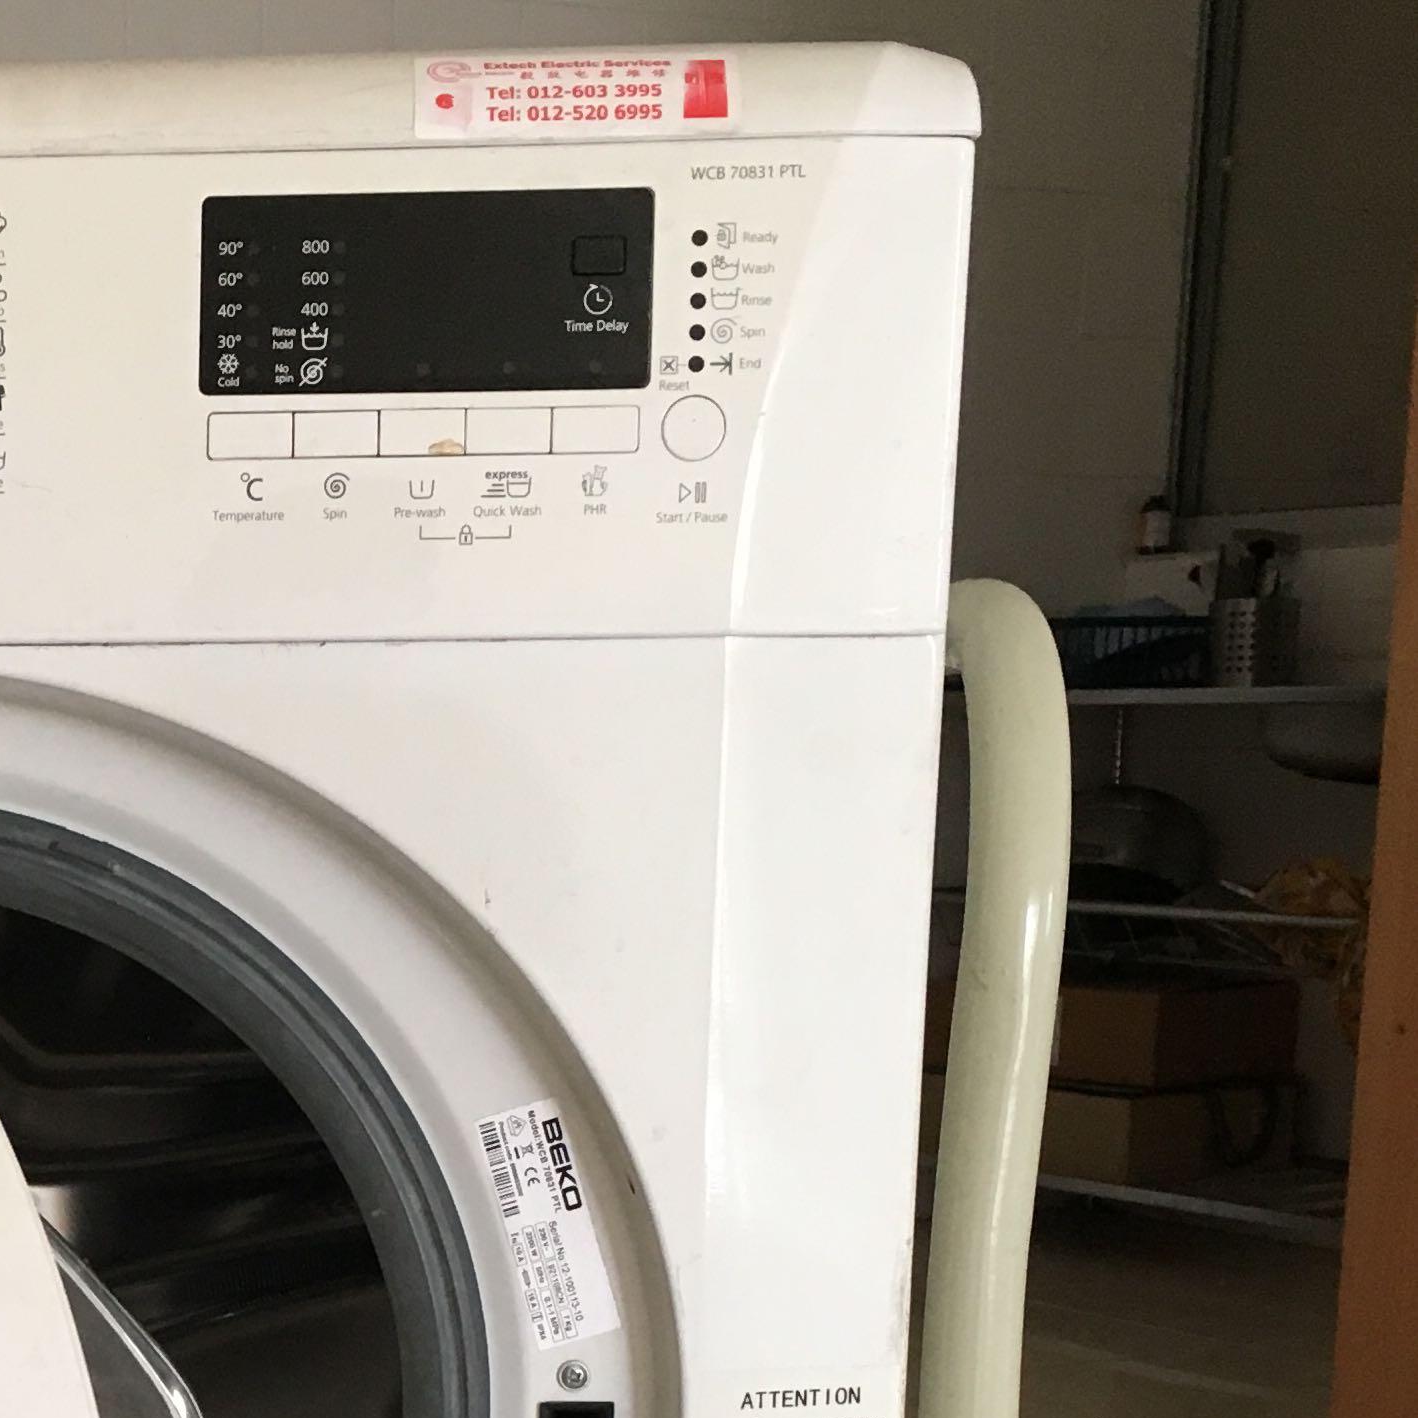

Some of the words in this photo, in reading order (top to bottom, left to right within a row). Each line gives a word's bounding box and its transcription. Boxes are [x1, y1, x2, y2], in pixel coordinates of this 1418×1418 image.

[484, 62, 536, 70] Extech
[541, 60, 600, 68] Electric
[604, 60, 671, 68] Services
[486, 86, 521, 100] Tel:
[527, 84, 608, 98] 012-603
[614, 83, 663, 98] 3995
[486, 107, 521, 122] Tel:
[527, 105, 608, 121] 012-520
[614, 104, 663, 120] 6995
[691, 166, 726, 180] WCB
[730, 165, 775, 179] 70831
[779, 164, 806, 178] PTL
[743, 231, 778, 245] Ready
[302, 240, 330, 254] 800
[742, 263, 775, 275] Wash
[301, 271, 329, 285] 600
[741, 295, 772, 306] Rinse
[301, 302, 329, 317] 400
[272, 327, 297, 337] Rinse
[565, 320, 593, 333] Time
[596, 319, 630, 335] Delay
[740, 326, 765, 340] Spin
[272, 339, 294, 350] hold
[275, 364, 290, 374] No
[739, 358, 762, 369] End
[218, 377, 240, 387] Cold
[275, 374, 294, 385] spin
[659, 380, 690, 392] Reset
[485, 470, 529, 482] express
[212, 510, 285, 523] Temperature
[322, 507, 348, 521] Spin
[394, 506, 446, 519] Pre-wash
[473, 505, 506, 518] Quick
[509, 504, 542, 517] Wash
[584, 504, 607, 516] PHR
[656, 512, 685, 524] Start
[694, 512, 728, 524] Pause
[540, 1116, 583, 1212] BEKO
[549, 1194, 562, 1214] PTL
[547, 1219, 563, 1246] Serial
[740, 1387, 861, 1410] ATTENTION
